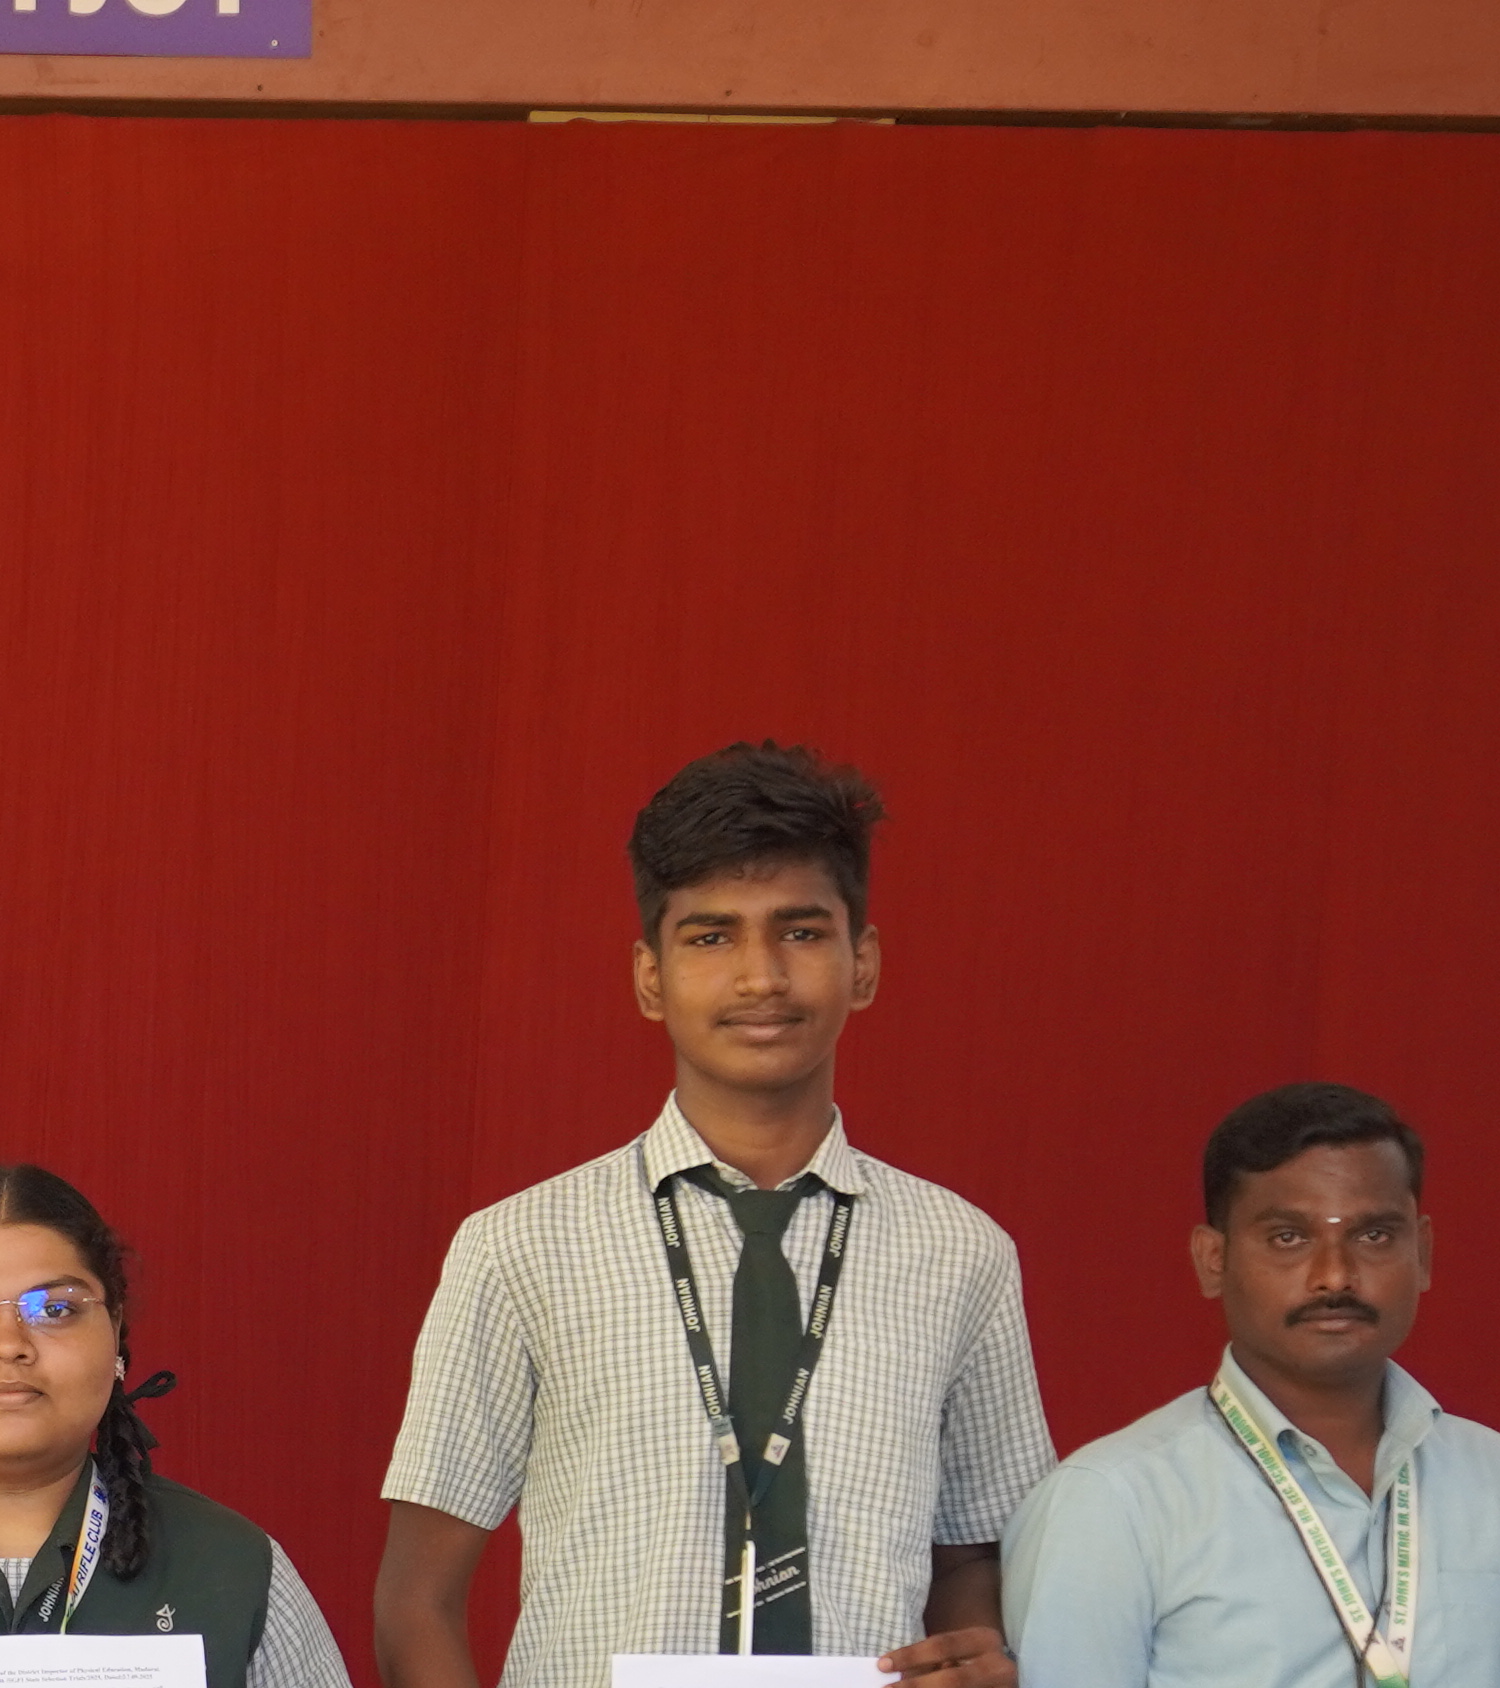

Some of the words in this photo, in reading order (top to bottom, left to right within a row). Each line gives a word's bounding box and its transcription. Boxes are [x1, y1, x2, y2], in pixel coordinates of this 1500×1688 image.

[659, 1197, 680, 1249] JOHNIAN
[829, 1205, 851, 1259] JOHNIAN
[677, 1278, 701, 1333] JOHNIAN
[810, 1284, 830, 1340] JOHNIAN
[698, 1365, 725, 1421] JOHNIAN
[782, 1367, 810, 1426] JOHNIAN
[1226, 1406, 1261, 1446] MADURAI
[1397, 1511, 1410, 1527] HR.
[77, 1543, 97, 1586] RIFLE
[88, 1510, 105, 1543] CLUB
[1308, 1526, 1339, 1568] MATRIC.
[1397, 1529, 1411, 1568] MATRIC.
[1330, 1568, 1357, 1607] JOHN'S
[1396, 1569, 1411, 1607] JOHN'S
[1394, 1608, 1410, 1625] ST.
